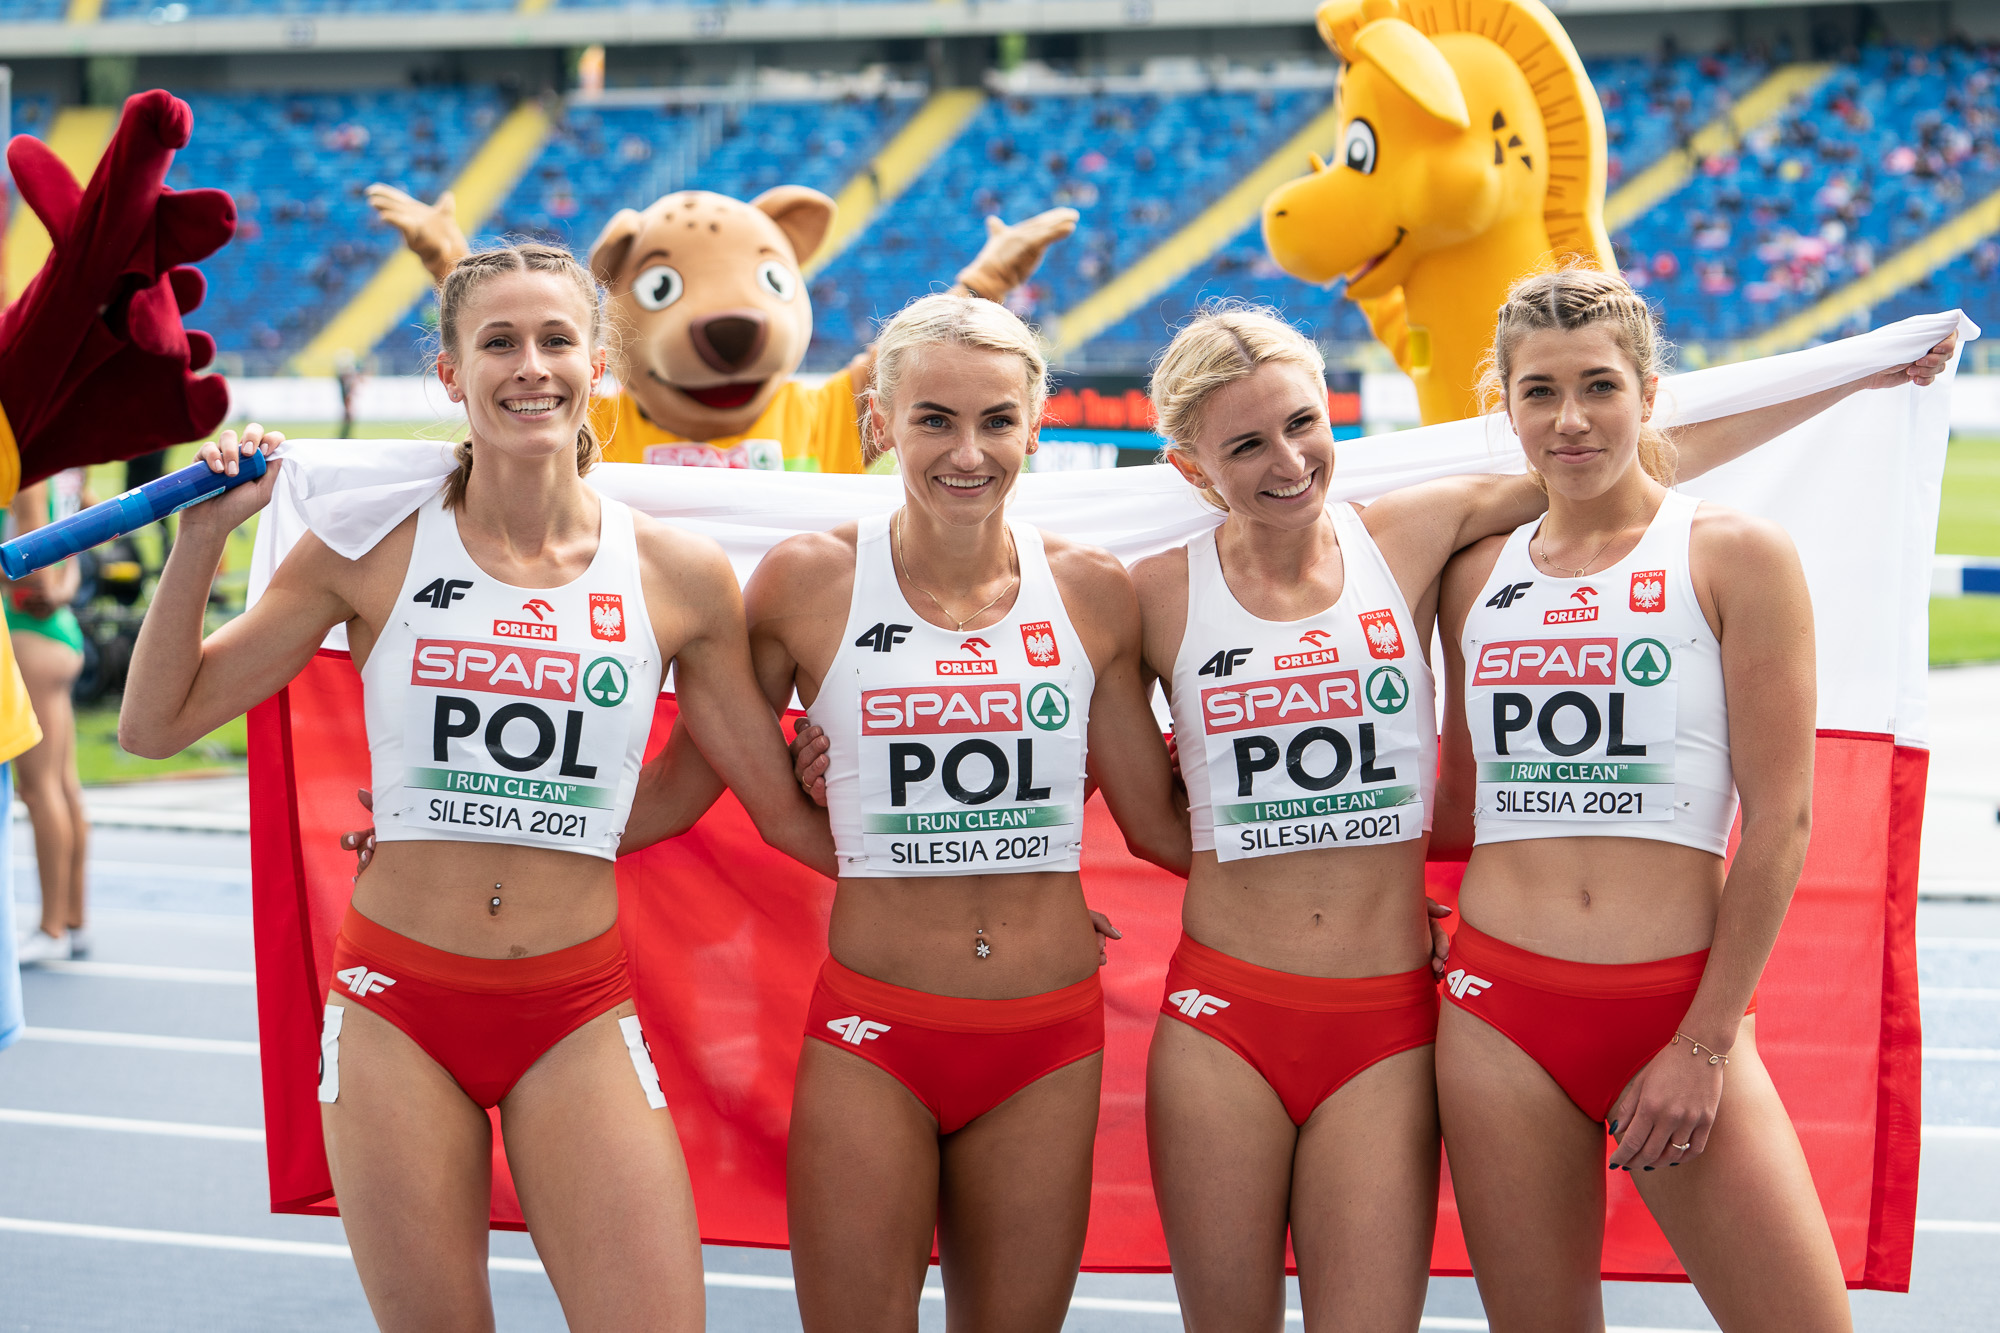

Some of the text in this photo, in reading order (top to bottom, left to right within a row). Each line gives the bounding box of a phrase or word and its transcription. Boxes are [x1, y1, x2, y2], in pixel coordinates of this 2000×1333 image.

[413, 578, 474, 609] 4F
[591, 595, 620, 603] POLSKA
[1485, 582, 1534, 609] 4F
[496, 623, 553, 638] ORLEN
[1022, 622, 1050, 631] POLSKA
[1361, 611, 1391, 621] POLSKA
[1547, 609, 1596, 623] ORLEN
[855, 622, 913, 652] 4F
[417, 646, 574, 694] SPAR
[939, 662, 994, 673] ORLEN
[1198, 648, 1254, 677] 4F
[1278, 651, 1335, 668] ORLEN
[1481, 644, 1613, 679] SPAR
[866, 691, 1018, 728] SPAR
[1206, 677, 1358, 727] SPAR
[433, 695, 597, 779] POL
[1493, 691, 1647, 757] POL
[889, 738, 1051, 807] POL
[1233, 722, 1397, 797] POL
[1510, 765, 1515, 779] I
[1517, 765, 1550, 780] RUN
[446, 773, 452, 788] I
[456, 776, 499, 792] RUN
[1255, 805, 1260, 819] I
[1266, 801, 1307, 818] RUN
[1496, 791, 1643, 814] SILESIA 2021
[428, 799, 587, 838] SILESIA 2021
[906, 816, 911, 831] I
[917, 815, 960, 830] RUN
[1240, 814, 1401, 850] SILESIA 2021
[891, 836, 1049, 864] SILESIA 2021
[337, 966, 396, 997] 4F
[1447, 969, 1493, 999] 4F
[1168, 989, 1231, 1019] 4F
[826, 1015, 891, 1045] 4F
